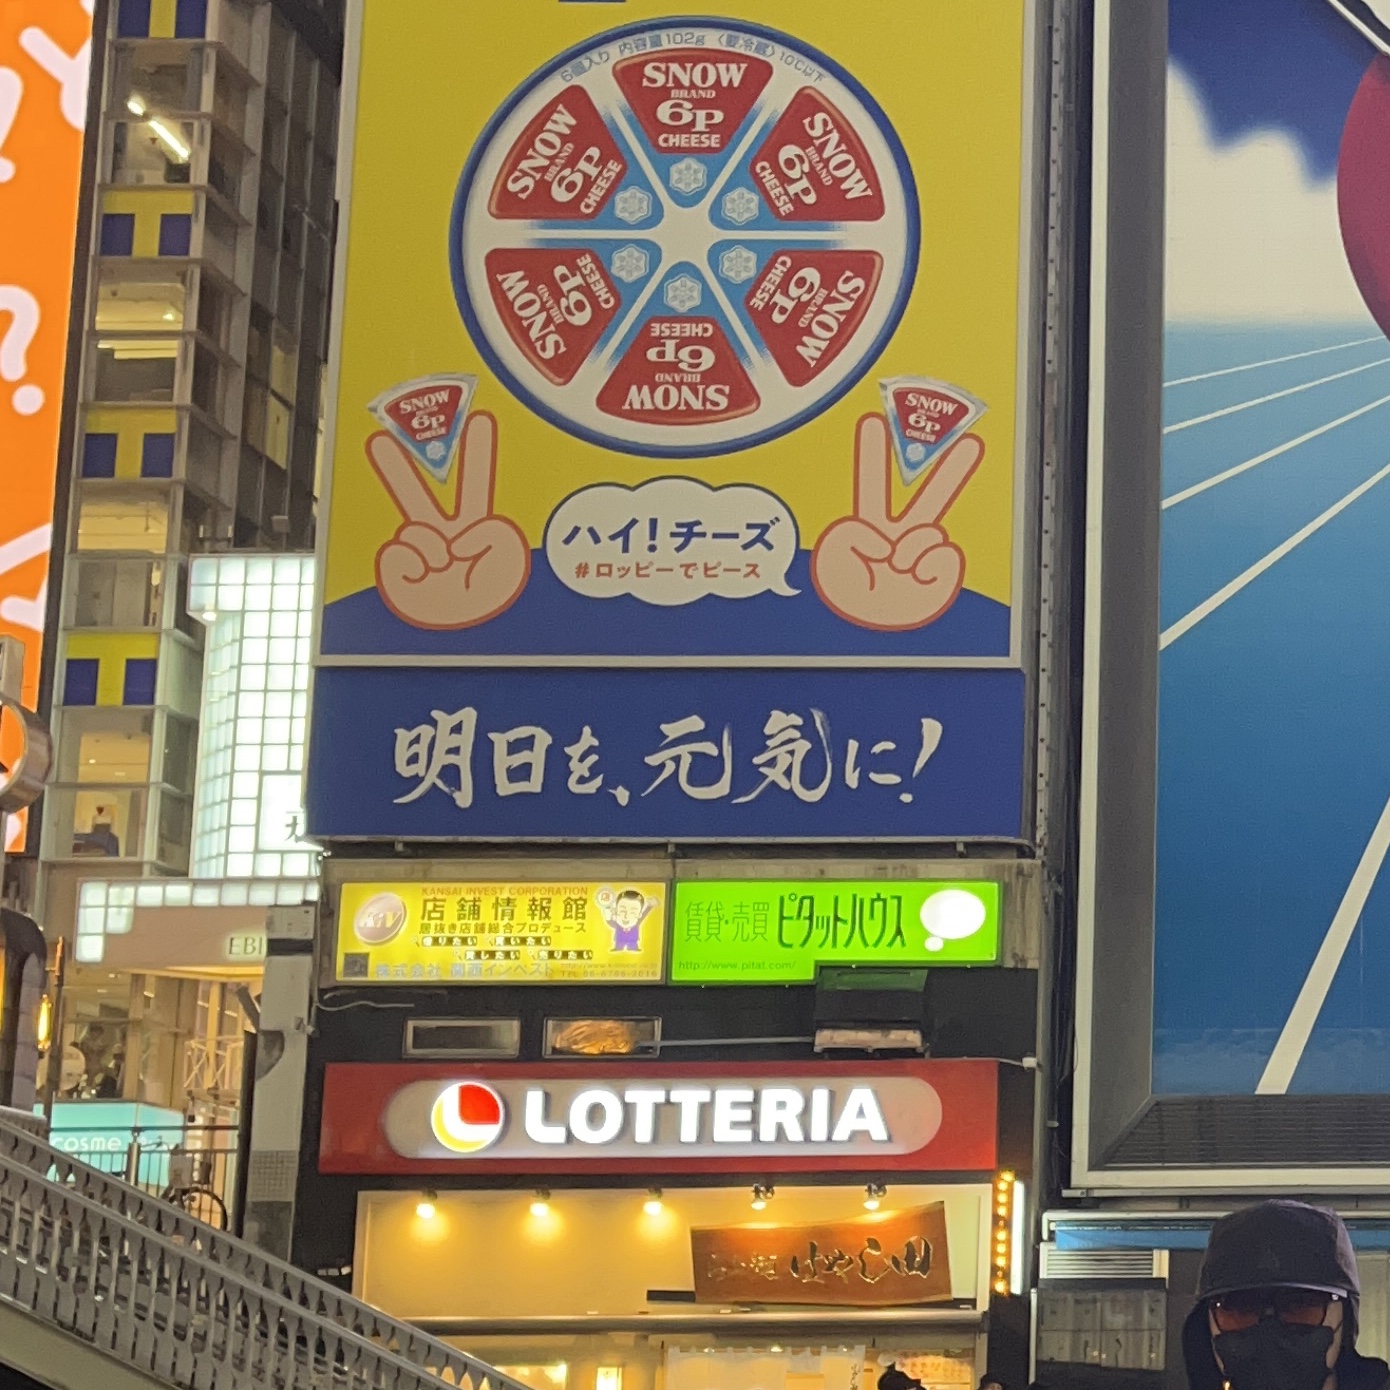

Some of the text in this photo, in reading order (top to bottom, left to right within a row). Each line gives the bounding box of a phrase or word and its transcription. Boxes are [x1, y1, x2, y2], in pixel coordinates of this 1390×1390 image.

[641, 62, 748, 89] SNOW
[671, 89, 716, 99] BRAND
[656, 100, 724, 131] 6P
[505, 104, 578, 200] SNOW
[657, 134, 721, 148] CHEESE
[803, 111, 873, 203] SNOW
[549, 145, 602, 205] 6P
[579, 159, 622, 215] CHEESE
[755, 161, 795, 217] CHEESE
[777, 143, 818, 207] 6P
[552, 263, 594, 327] 6P
[575, 253, 616, 310] CHEESE
[750, 255, 792, 311] CHEESE
[771, 266, 822, 325] 6P
[496, 270, 567, 361] SNOW
[650, 323, 713, 338] CHEESE
[794, 270, 867, 368] SNOW
[646, 340, 716, 371] 6P
[655, 373, 701, 383] BRAND
[399, 389, 451, 415] SNOW
[622, 384, 730, 411] SNOW
[905, 392, 958, 416] SNOW
[562, 517, 780, 554] ハイ!チーズ
[575, 561, 760, 579] #ロッピーでピース
[394, 706, 943, 808] 明日を、元気に!
[420, 897, 587, 922] 店舗情報館
[422, 886, 588, 896] KANSAI INVEST CORPORATION
[685, 892, 906, 949] 賃貸・売買 ピタットハウス
[678, 960, 796, 971] http://www.pitat.com/
[525, 1088, 891, 1145] LOTTERIA
